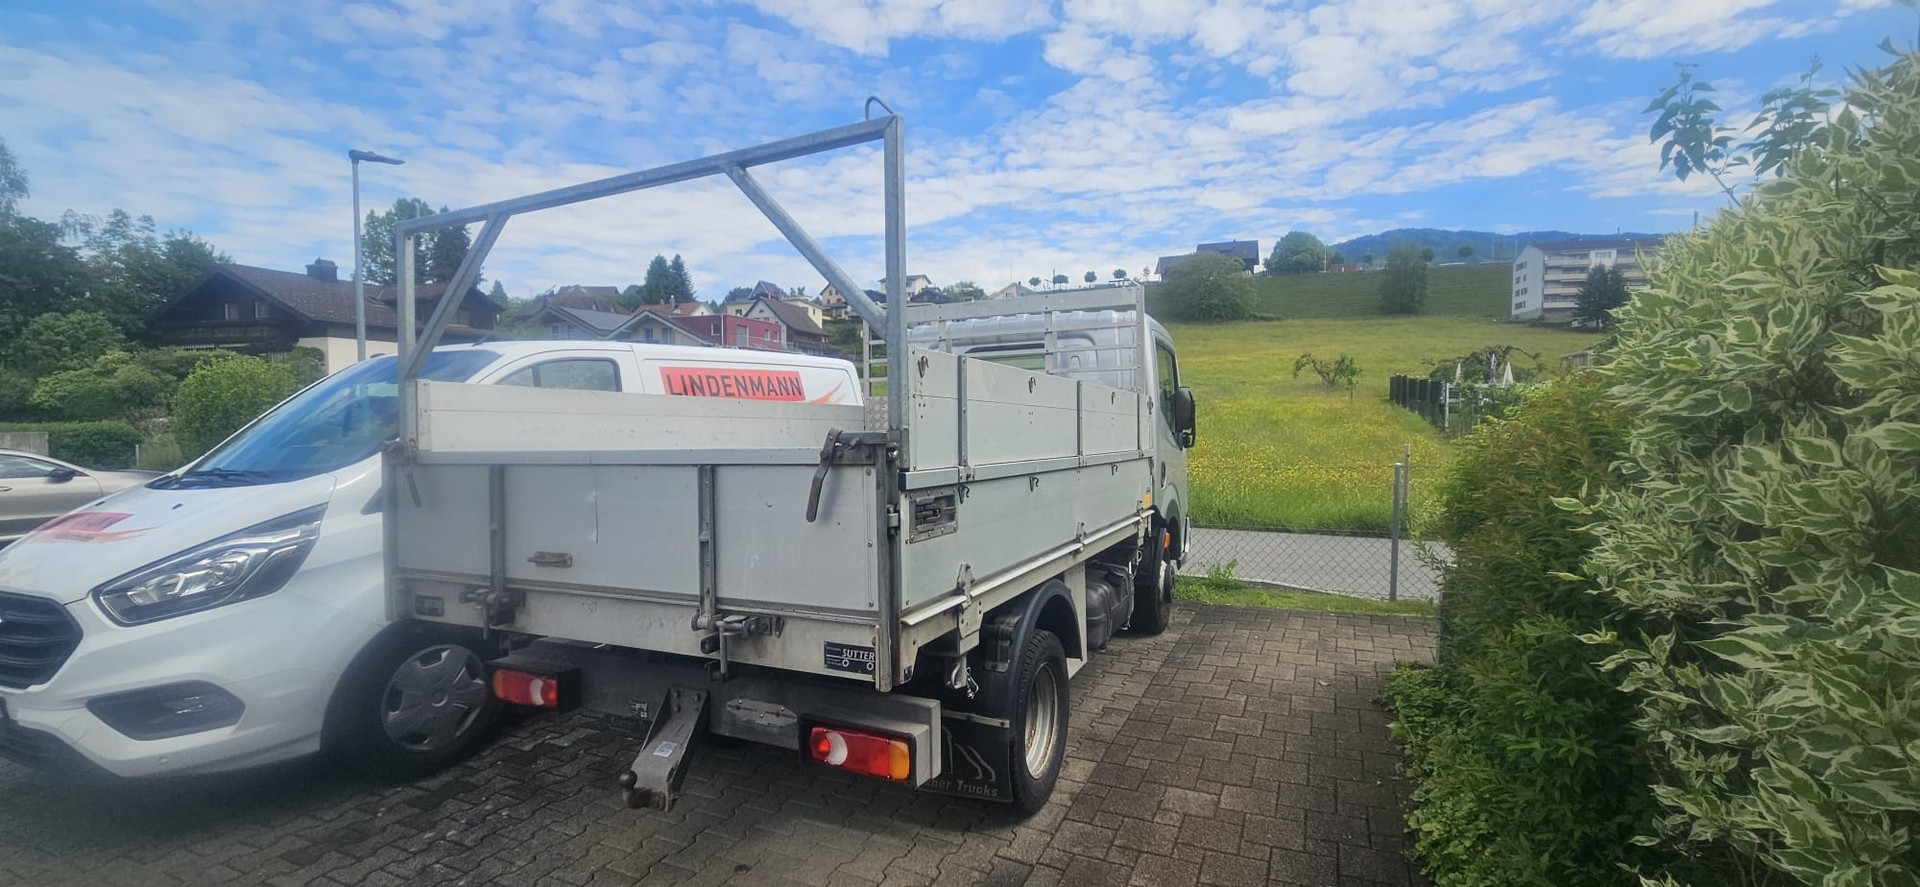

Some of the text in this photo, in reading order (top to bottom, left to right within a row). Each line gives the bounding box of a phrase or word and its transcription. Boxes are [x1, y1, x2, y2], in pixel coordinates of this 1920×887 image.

[666, 374, 802, 397] LINDENMANN
[842, 648, 875, 661] SUTTER
[956, 779, 999, 797] Trucks
